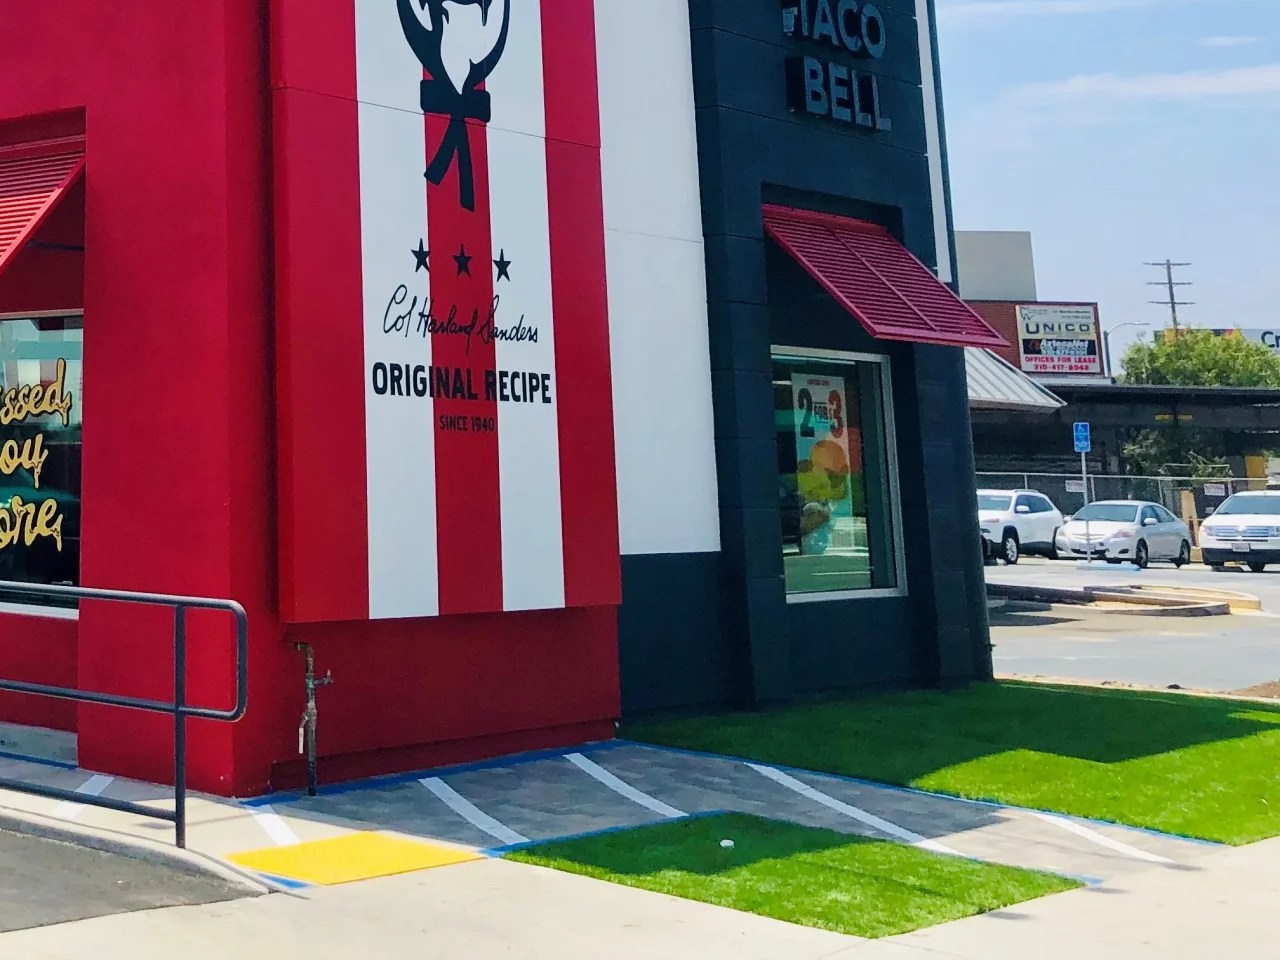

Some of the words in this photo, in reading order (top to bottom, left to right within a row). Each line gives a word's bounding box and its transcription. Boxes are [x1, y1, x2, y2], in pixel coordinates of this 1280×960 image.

[804, 55, 892, 132] BELL
[1025, 322, 1091, 335] UNICO
[1074, 356, 1097, 364] LEASE
[372, 361, 478, 401] ORIGINAL
[484, 369, 552, 404] RECIPE
[439, 414, 468, 432] SINCE
[471, 415, 495, 432] 1940
